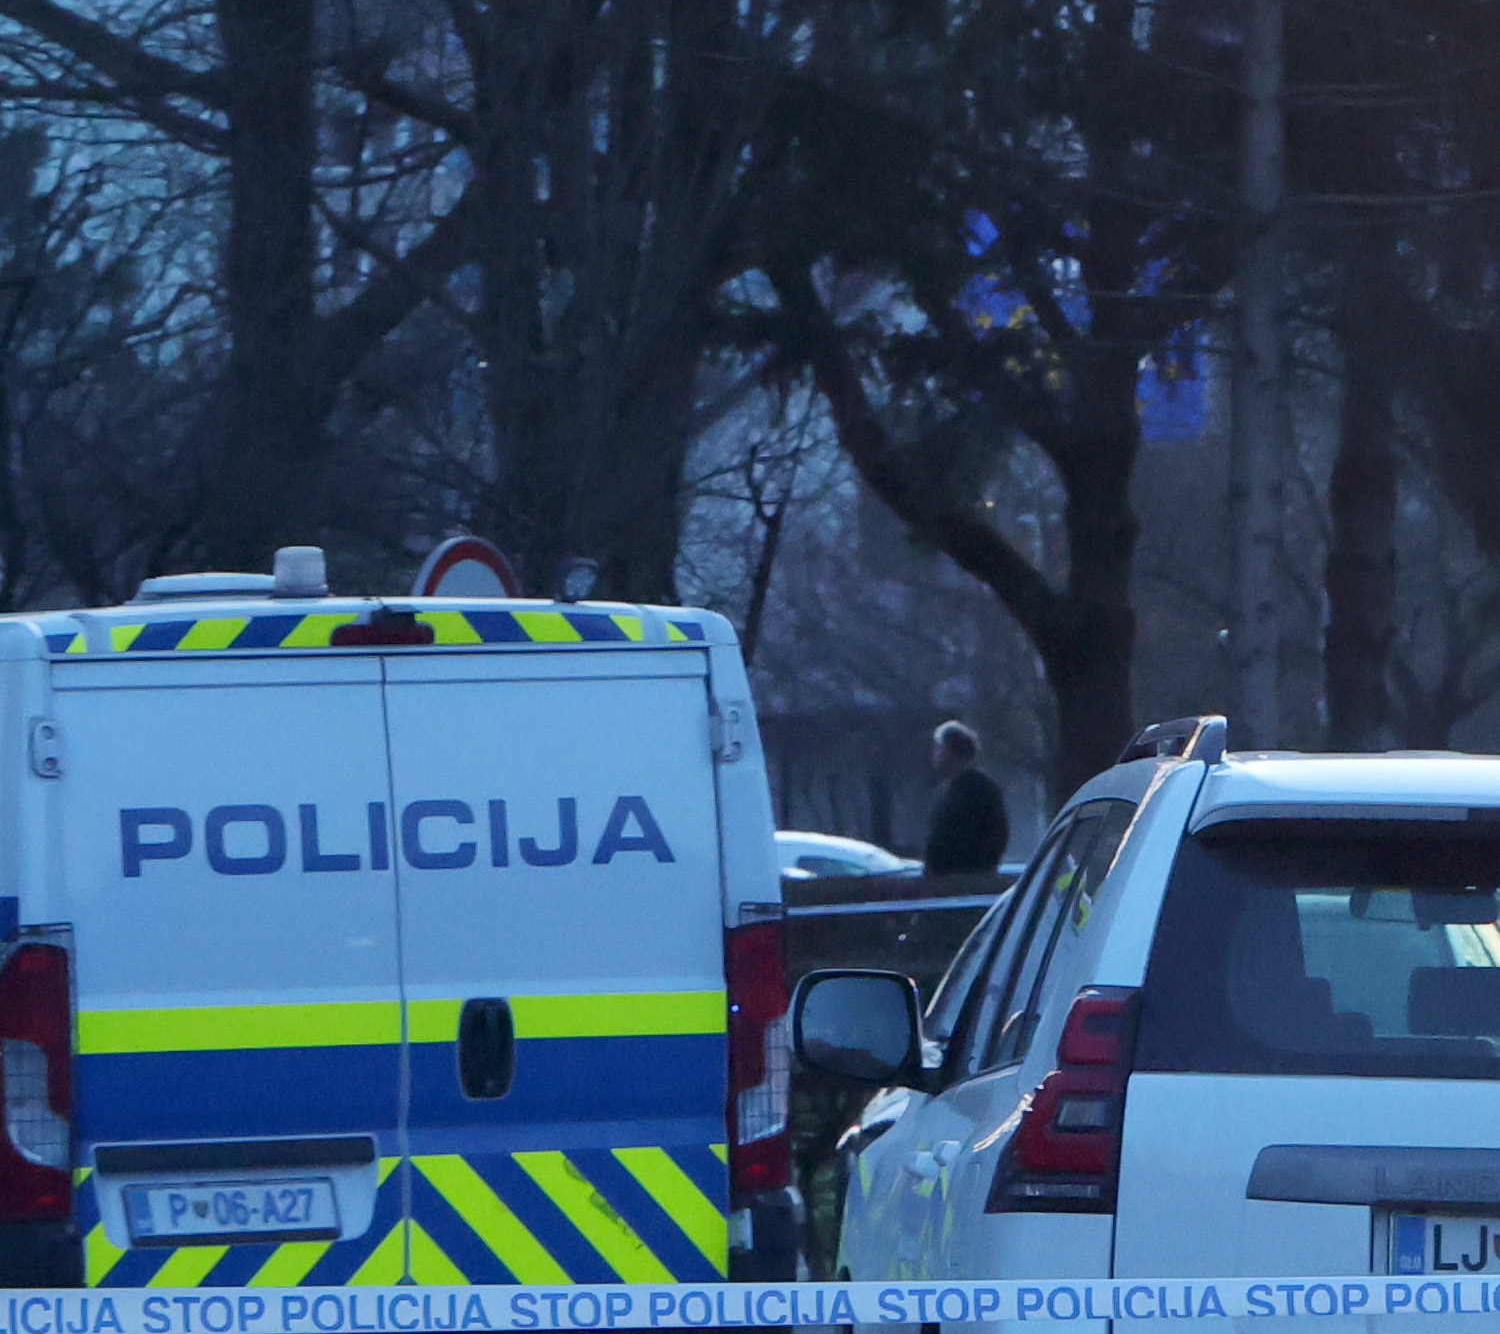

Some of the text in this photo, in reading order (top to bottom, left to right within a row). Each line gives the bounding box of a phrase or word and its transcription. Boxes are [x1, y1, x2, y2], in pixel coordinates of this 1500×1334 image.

[119, 795, 676, 878] POLICIJA
[1433, 1223, 1488, 1272] LJ
[143, 1295, 265, 1333] STOP
[281, 1293, 491, 1331] POLICIJA
[510, 1291, 633, 1328] STOP
[648, 1289, 859, 1327] POLICIJA
[878, 1287, 1000, 1323] STOP
[1017, 1285, 1227, 1320] POLICIJA
[1245, 1282, 1370, 1318] STOP
